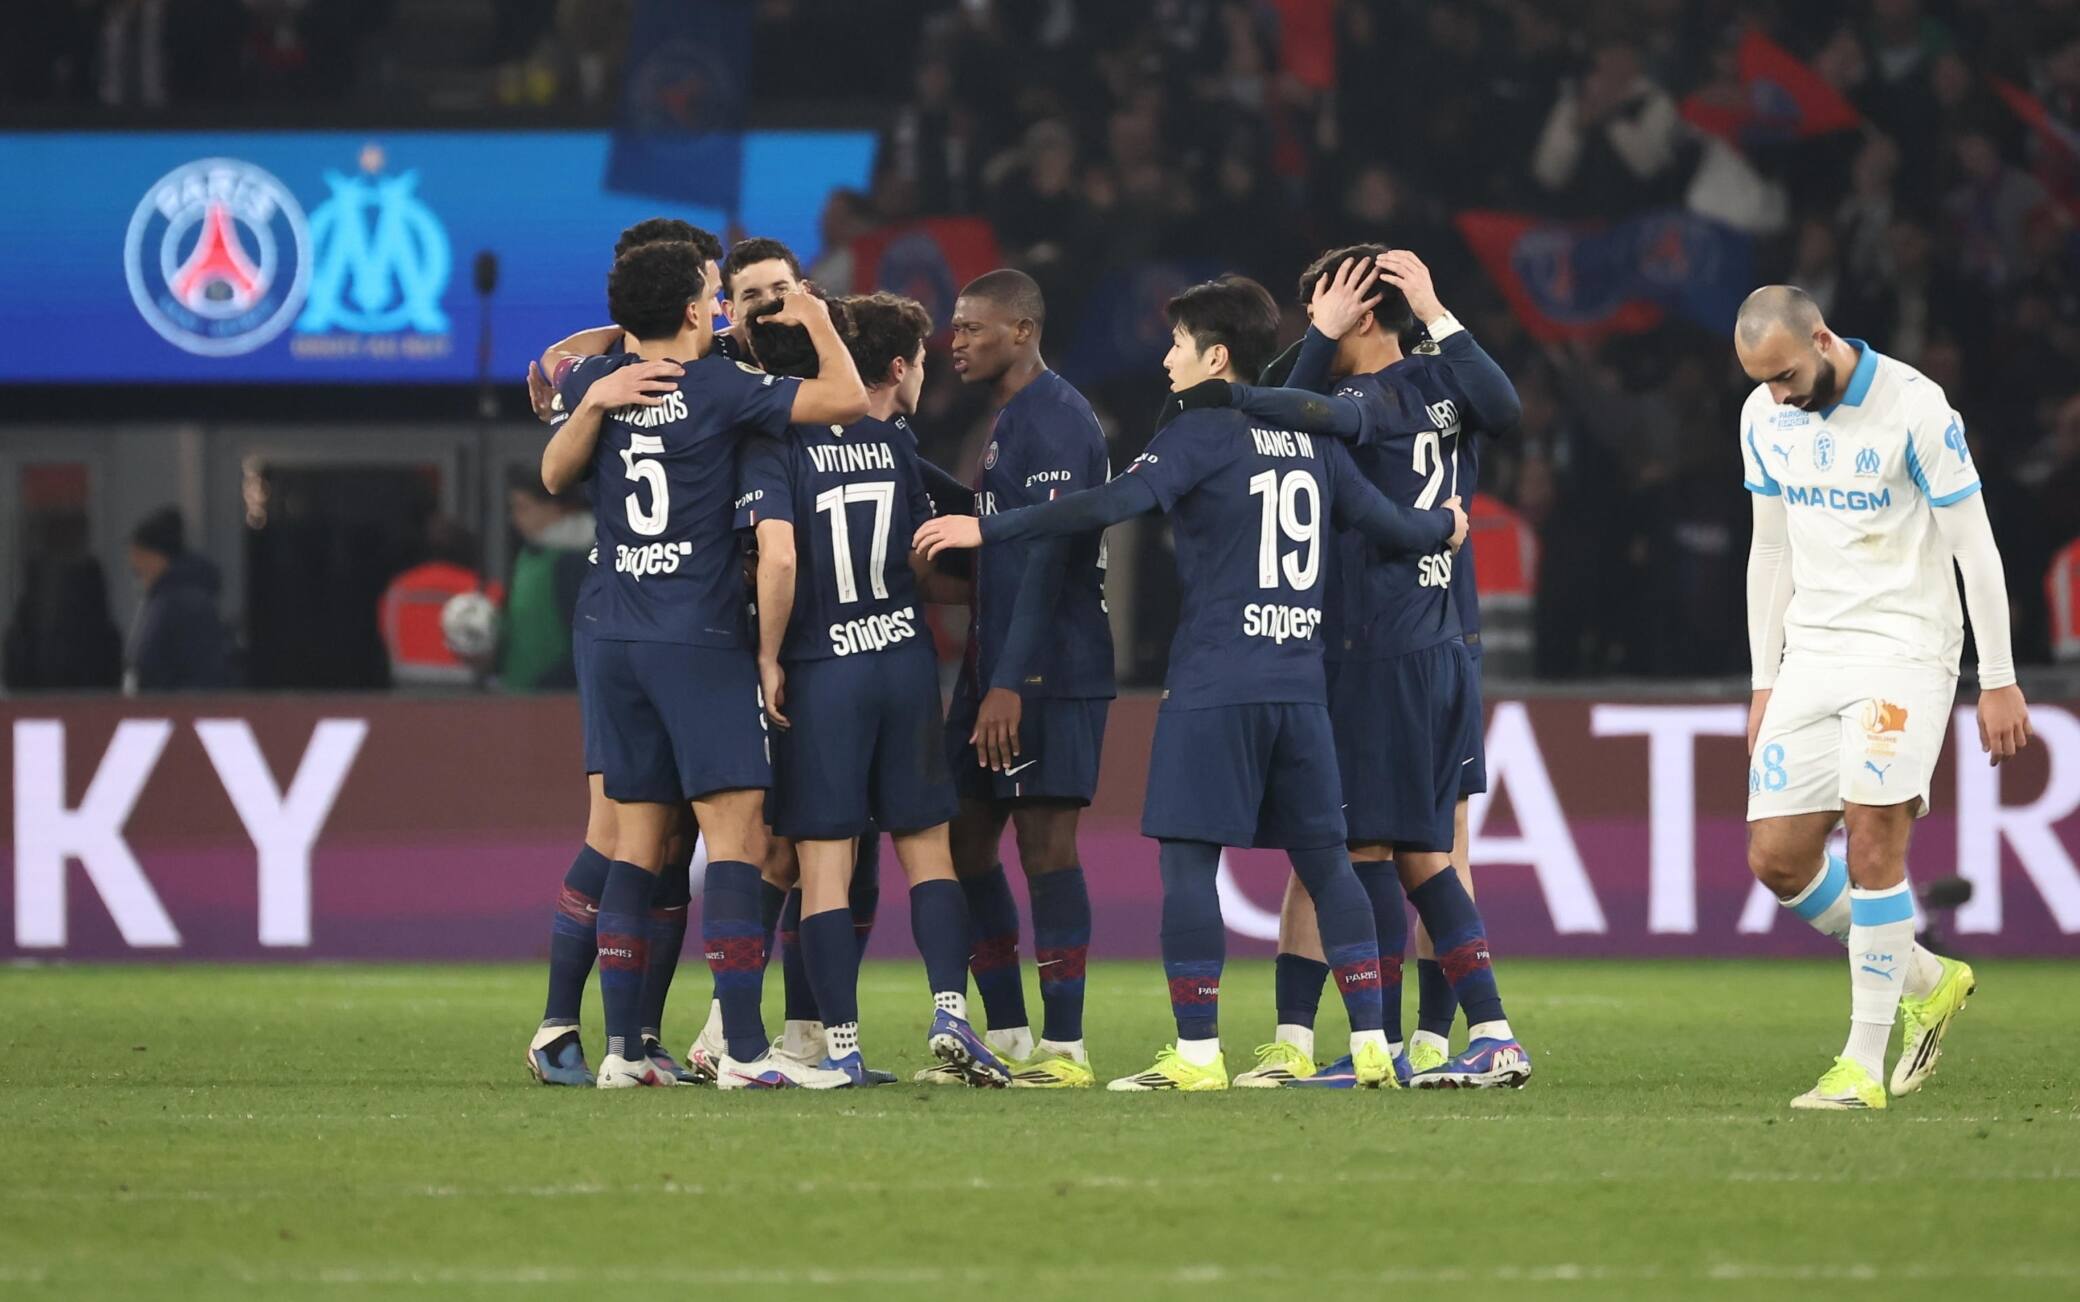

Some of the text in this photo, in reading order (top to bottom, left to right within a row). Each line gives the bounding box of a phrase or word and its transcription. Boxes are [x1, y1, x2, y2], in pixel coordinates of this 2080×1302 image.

[807, 442, 895, 473] VITINHA
[1250, 428, 1315, 459] KANG IN
[620, 432, 669, 536] 5
[1025, 470, 1071, 488] EYOND
[1781, 486, 1891, 511] MA CGM
[816, 481, 895, 604] 17
[1249, 468, 1321, 591] 19
[828, 606, 915, 657] snipes
[1763, 743, 1787, 791] 8
[12, 717, 370, 948] KY
[1345, 970, 1378, 984] PARIS
